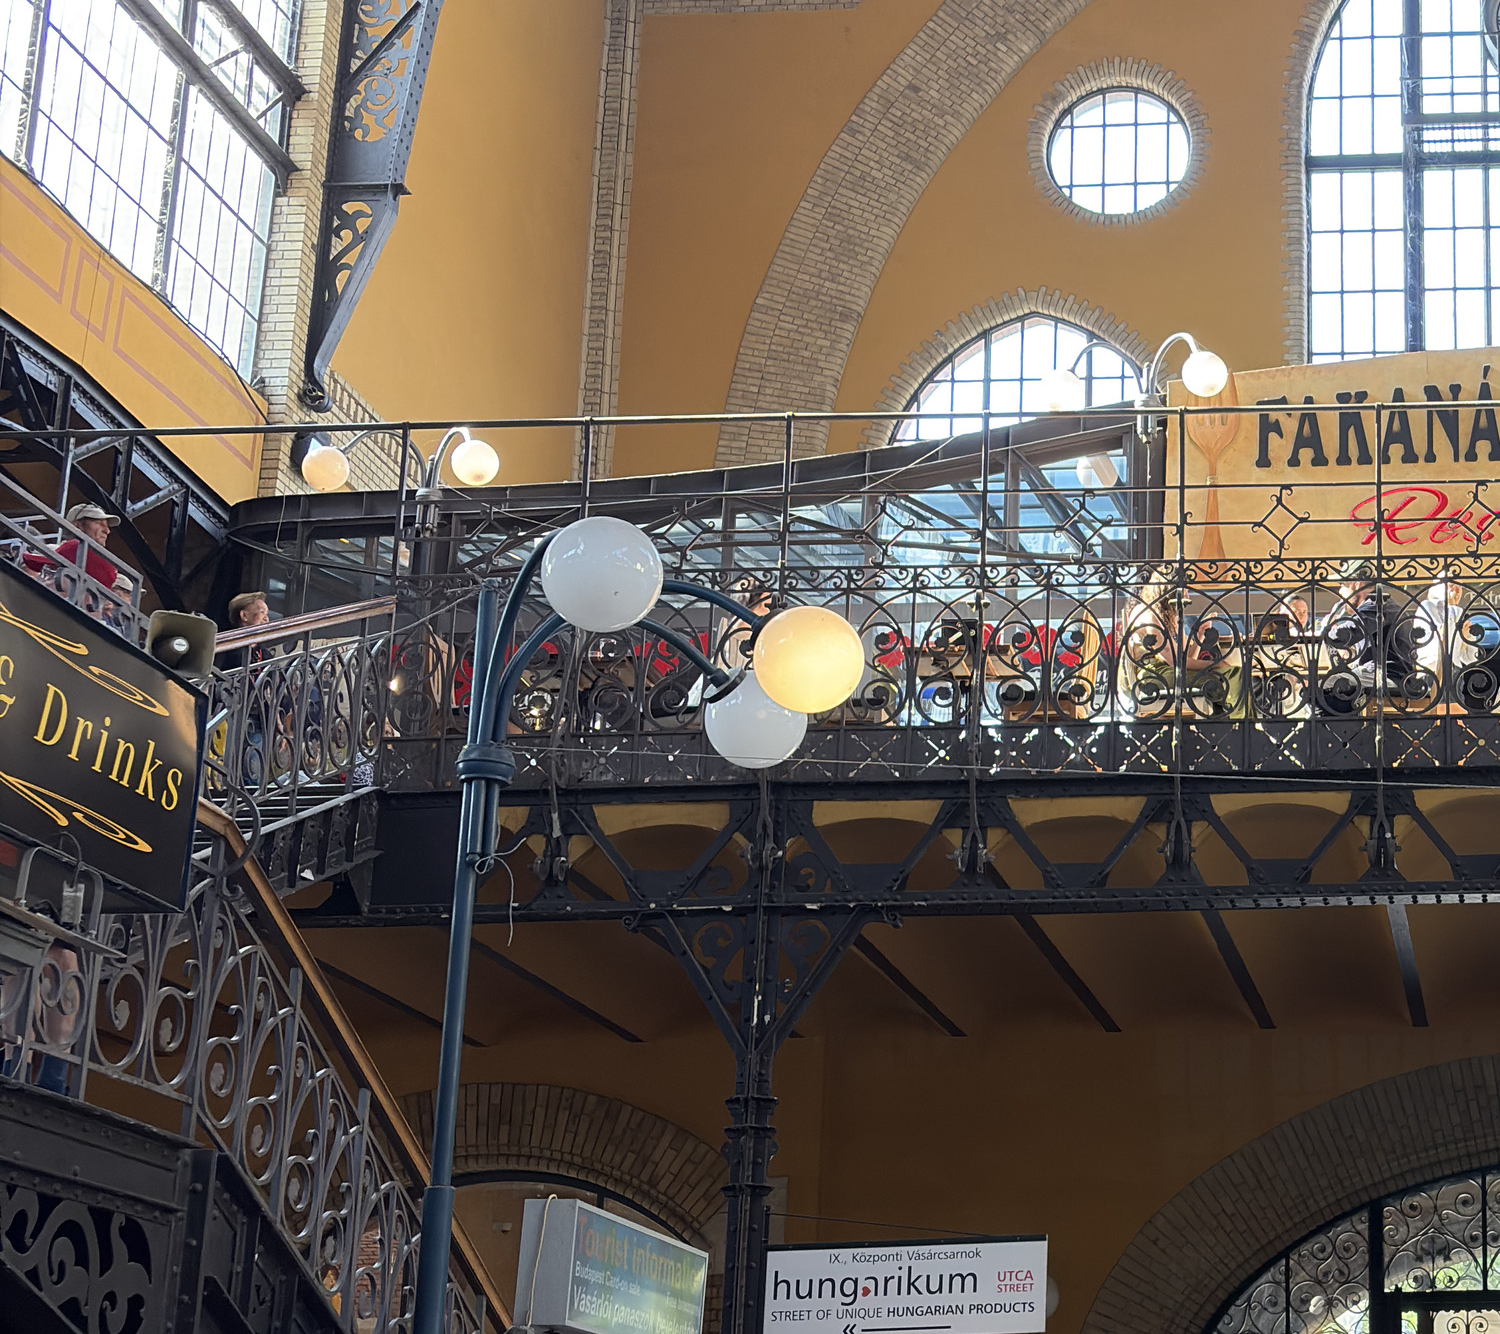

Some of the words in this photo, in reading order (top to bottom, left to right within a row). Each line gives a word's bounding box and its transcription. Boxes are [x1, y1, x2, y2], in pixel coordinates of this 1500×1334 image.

[33, 683, 183, 812] Drinks
[578, 1215, 629, 1270] Tourist
[852, 1249, 904, 1267] Központi
[907, 1248, 982, 1261] Vásárcsarnok
[575, 1260, 605, 1285] Budapest
[997, 1270, 1034, 1283] UTCA
[772, 1266, 978, 1306] hungarikum
[997, 1283, 1034, 1294] STREET
[573, 1285, 612, 1320] Vásárlói
[613, 1303, 653, 1332] panaszok
[771, 1308, 811, 1322] STREET
[816, 1307, 832, 1321] OF
[836, 1306, 883, 1321] UNIQUE
[886, 1303, 964, 1319] HUNGARIAN
[968, 1301, 1035, 1316] PRODUCTS
